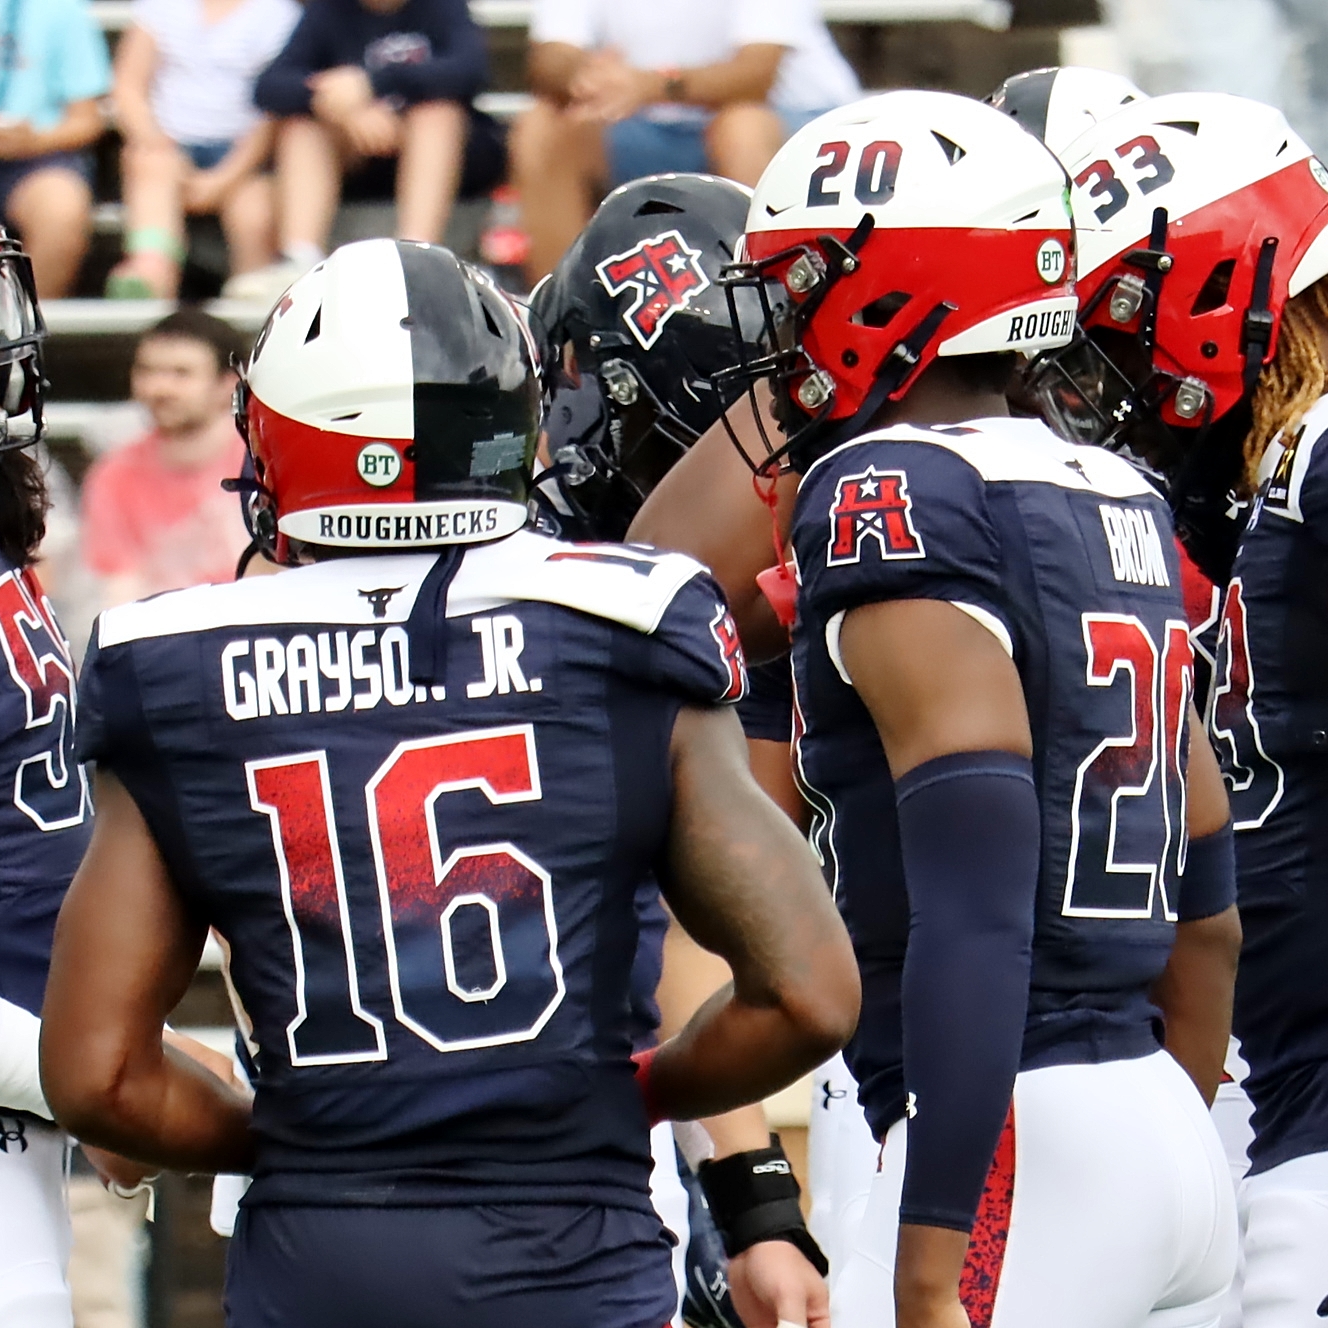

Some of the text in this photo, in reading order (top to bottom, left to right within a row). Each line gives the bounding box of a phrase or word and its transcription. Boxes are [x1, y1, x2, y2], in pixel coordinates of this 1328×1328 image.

[806, 140, 904, 206] 20
[1073, 134, 1176, 225] 33
[1041, 250, 1062, 271] BT
[362, 454, 395, 476] BT
[318, 507, 499, 541] ROUGHNECKS
[466, 614, 544, 699] JR.
[244, 722, 567, 1067] 16
